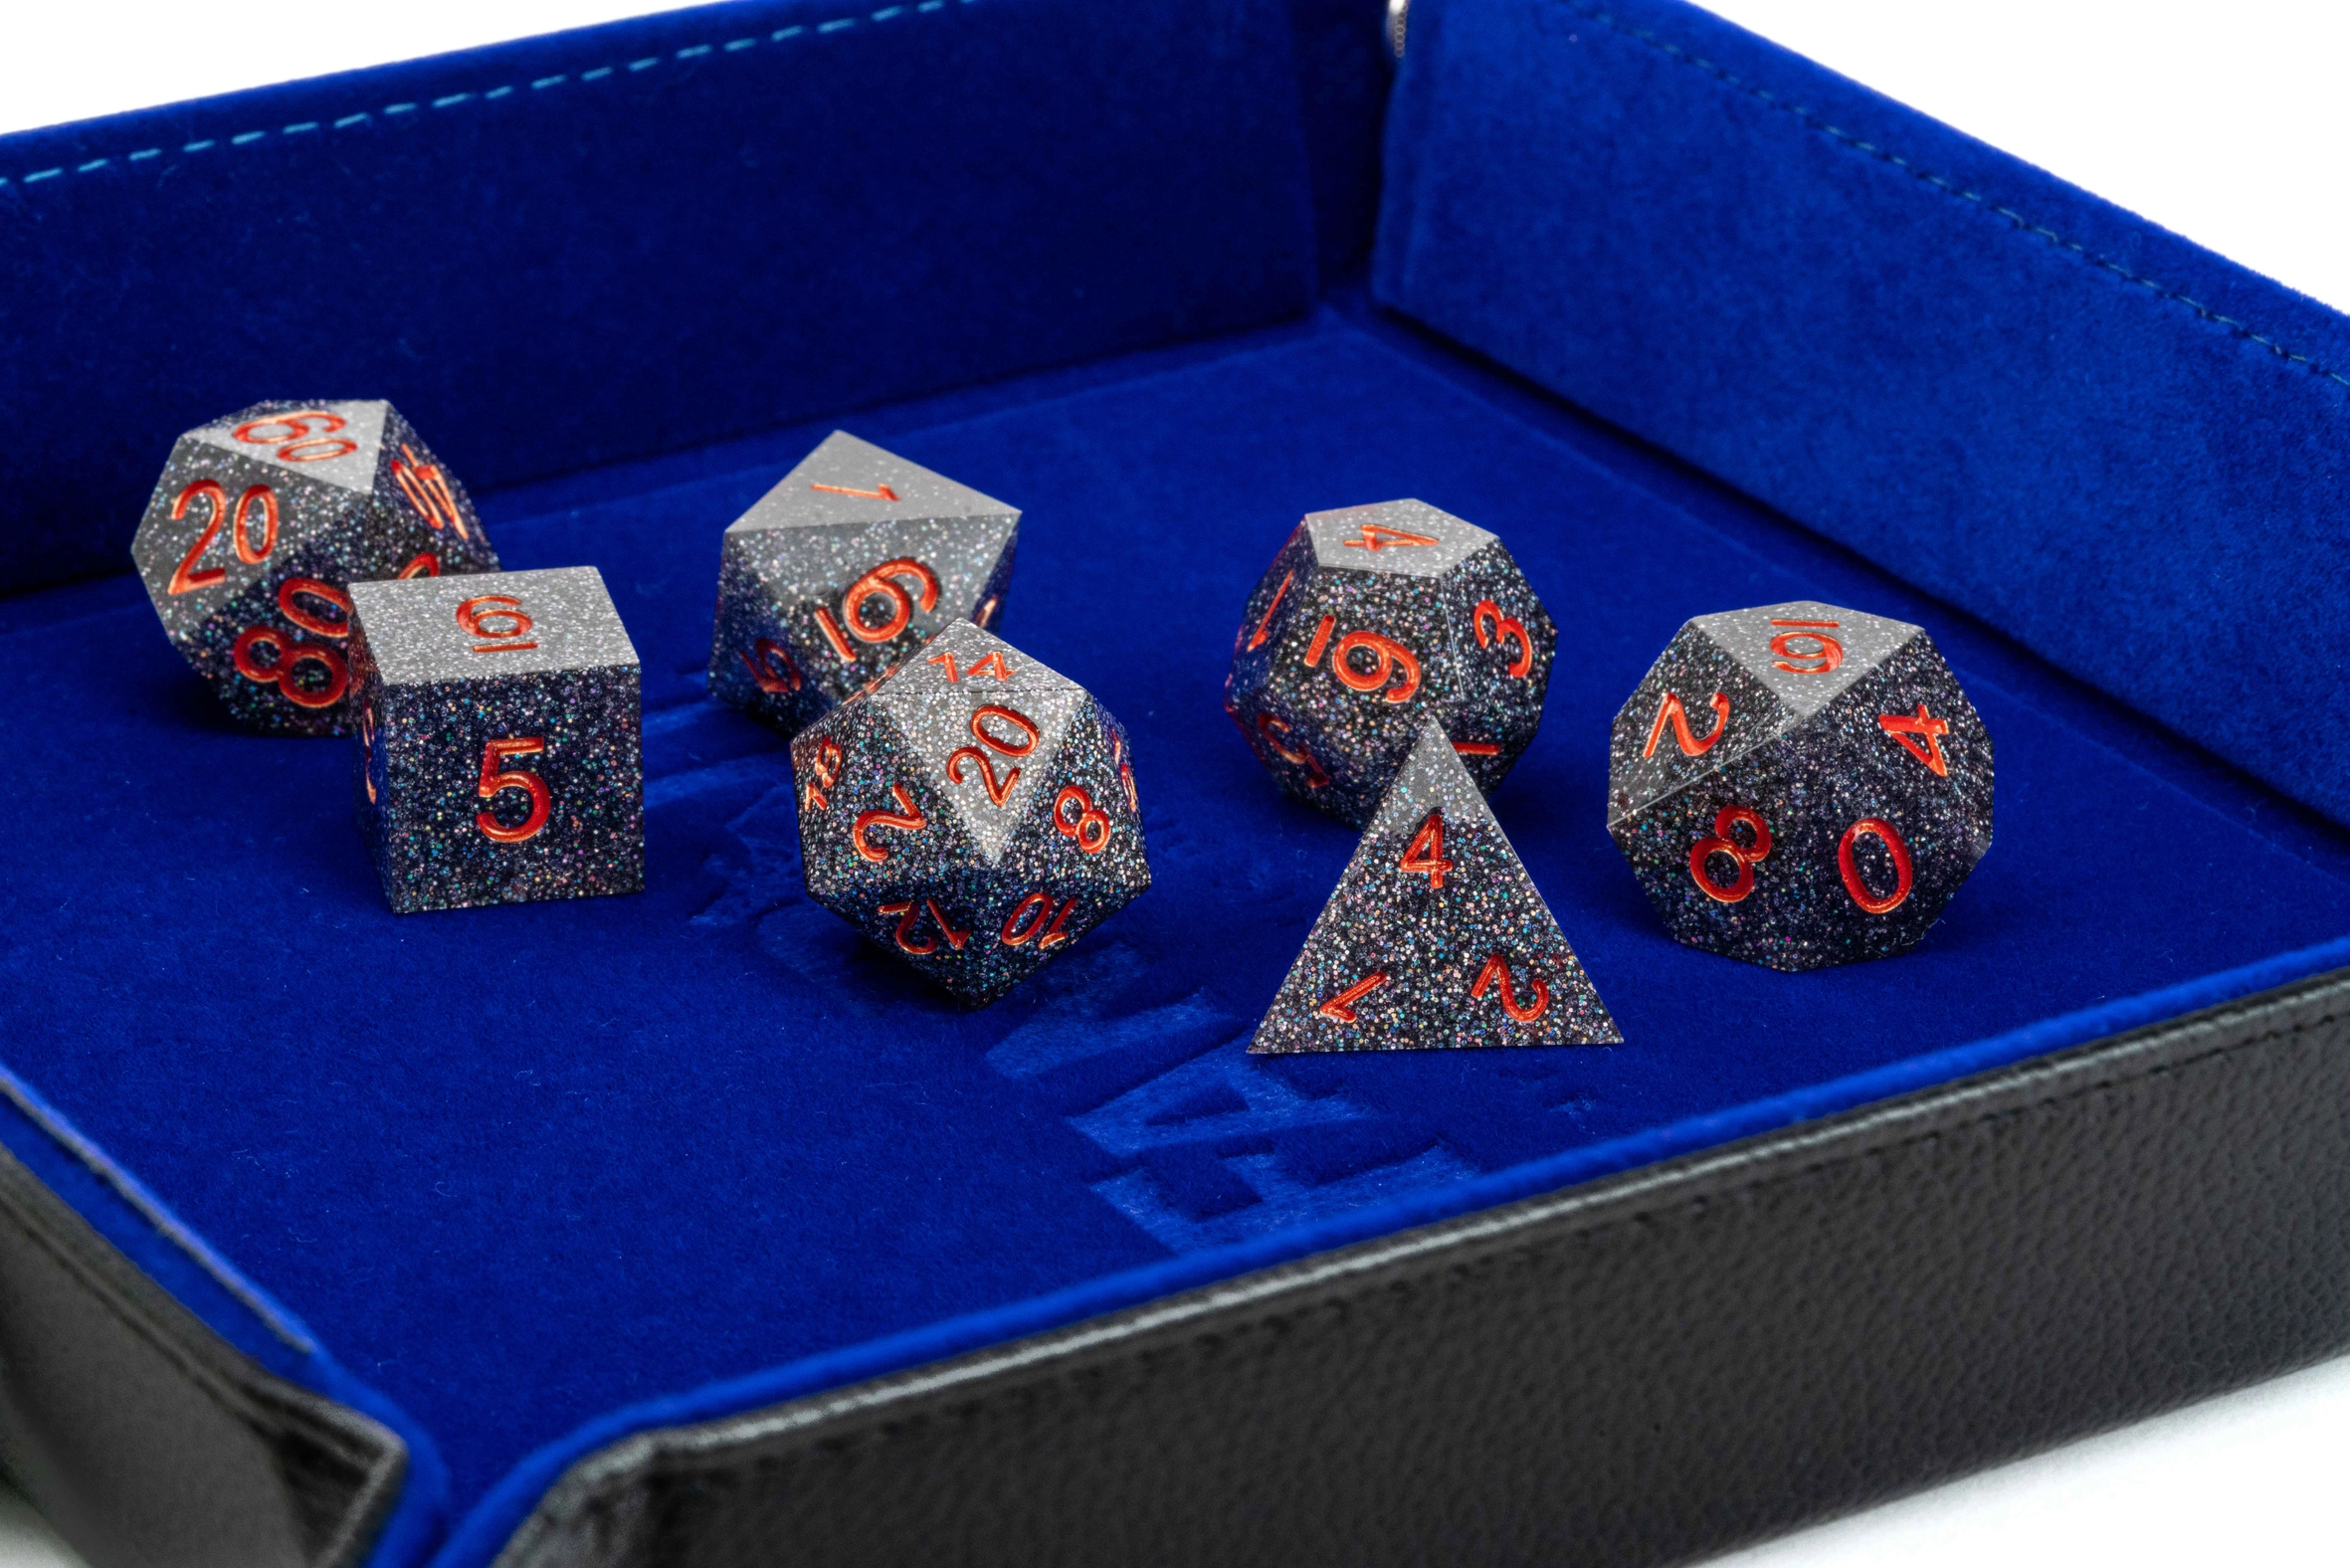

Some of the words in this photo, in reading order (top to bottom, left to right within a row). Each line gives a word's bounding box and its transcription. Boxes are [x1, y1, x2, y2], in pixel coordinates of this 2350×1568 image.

[168, 478, 280, 596] 20
[1343, 523, 1441, 553] 4
[233, 576, 354, 709] 80
[456, 594, 539, 655] 6
[1473, 599, 1533, 681] 3
[927, 652, 1019, 685] 14
[945, 702, 1042, 810] 20
[1643, 691, 1731, 760] 2
[1877, 704, 1950, 779] 4
[476, 735, 552, 845] 5
[851, 782, 928, 865] 2
[1053, 784, 1112, 856] 8
[1400, 814, 1455, 890] 4
[1689, 805, 1773, 904] 8
[1838, 817, 1914, 916] 0
[1001, 892, 1078, 950] 10
[1470, 952, 1552, 1034] 2
